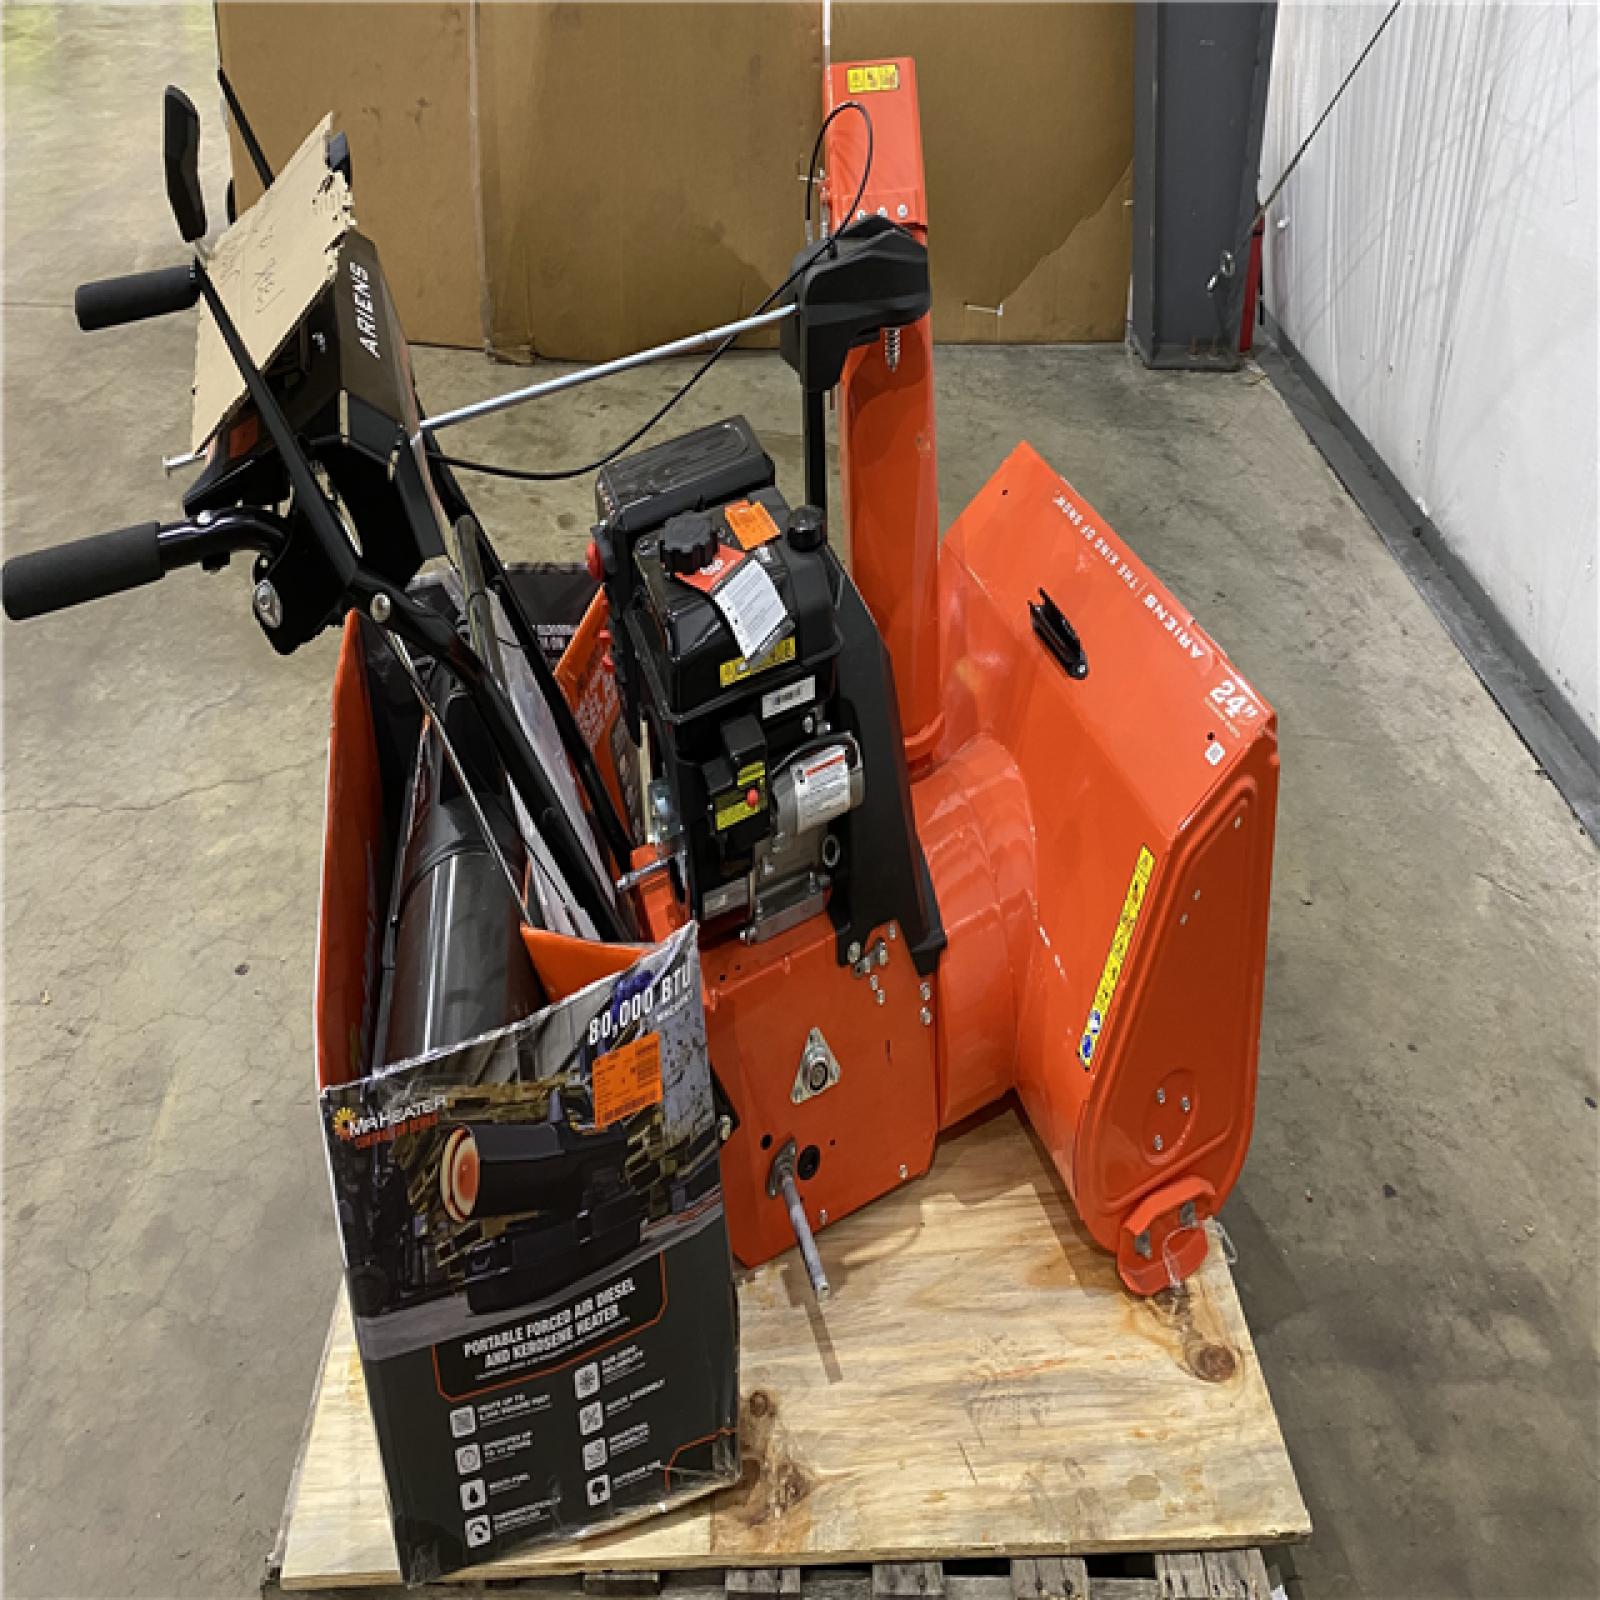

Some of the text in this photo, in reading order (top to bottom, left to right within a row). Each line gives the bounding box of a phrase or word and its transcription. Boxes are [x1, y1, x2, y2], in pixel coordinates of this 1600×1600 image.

[349, 262, 380, 359] ARIENS
[1080, 524, 1096, 541] OF
[1094, 537, 1120, 567] KING
[1117, 562, 1140, 589] THE
[1143, 594, 1205, 659] ARIENS
[589, 988, 653, 1046] 80,000
[661, 960, 692, 1004] BTU
[464, 1326, 524, 1359] PORTABLE
[526, 1308, 572, 1339] FORCED
[574, 1296, 595, 1320] AIR
[595, 1276, 637, 1308] DIESEL
[484, 1348, 511, 1369] AND
[512, 1323, 575, 1360] KEROSENE
[575, 1303, 620, 1336] HEATER
